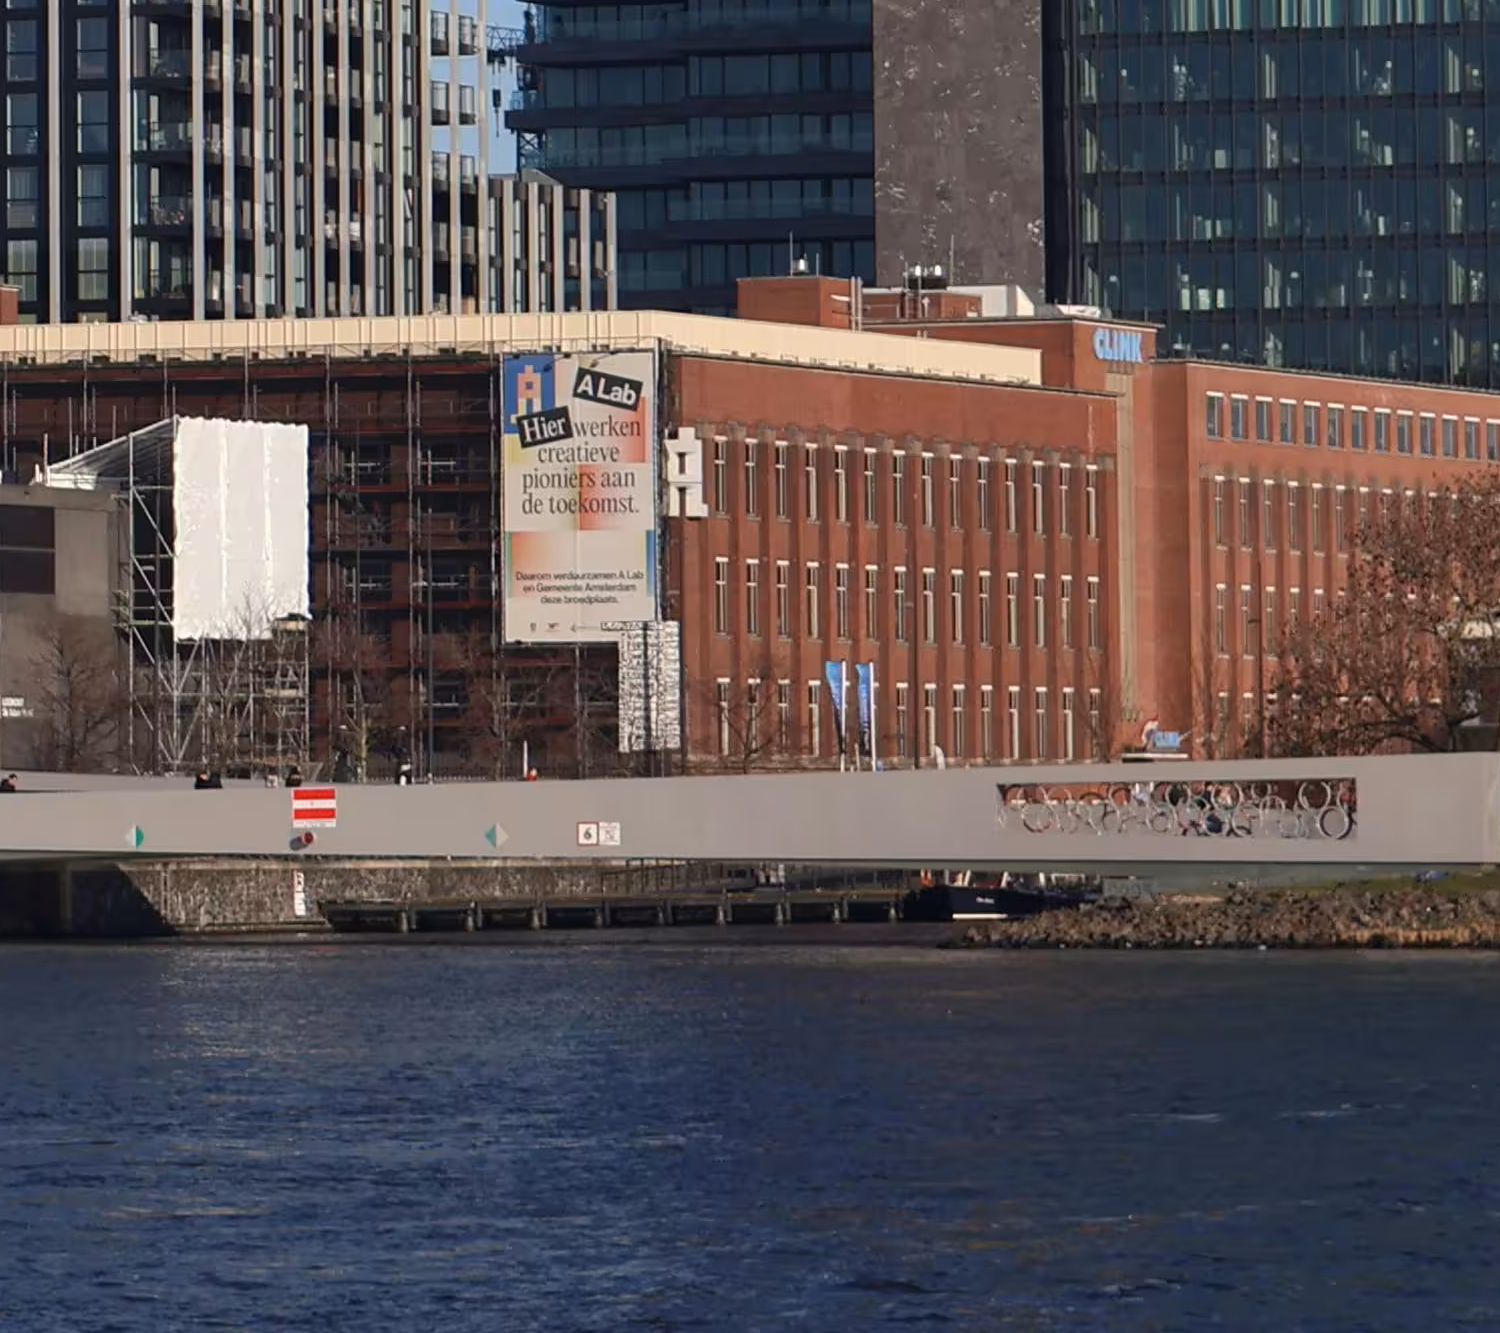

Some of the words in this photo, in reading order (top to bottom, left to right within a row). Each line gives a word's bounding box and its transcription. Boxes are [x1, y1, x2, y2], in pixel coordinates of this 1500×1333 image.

[1093, 327, 1143, 363] CLINK
[577, 374, 594, 396] A
[597, 377, 637, 406] Lab
[521, 416, 567, 443] Hier
[574, 415, 641, 437] werken
[537, 441, 620, 463] creatieve
[521, 468, 597, 494] pioniers
[600, 470, 636, 488] aan
[521, 494, 544, 515] de
[550, 494, 640, 514] toekomst.
[516, 571, 551, 581] Daarom
[627, 571, 644, 580] Lab
[523, 585, 535, 593] en
[536, 584, 583, 593] Gemeente
[585, 583, 637, 592] Amsterdam
[540, 595, 562, 604] deze
[583, 827, 592, 841] 6
